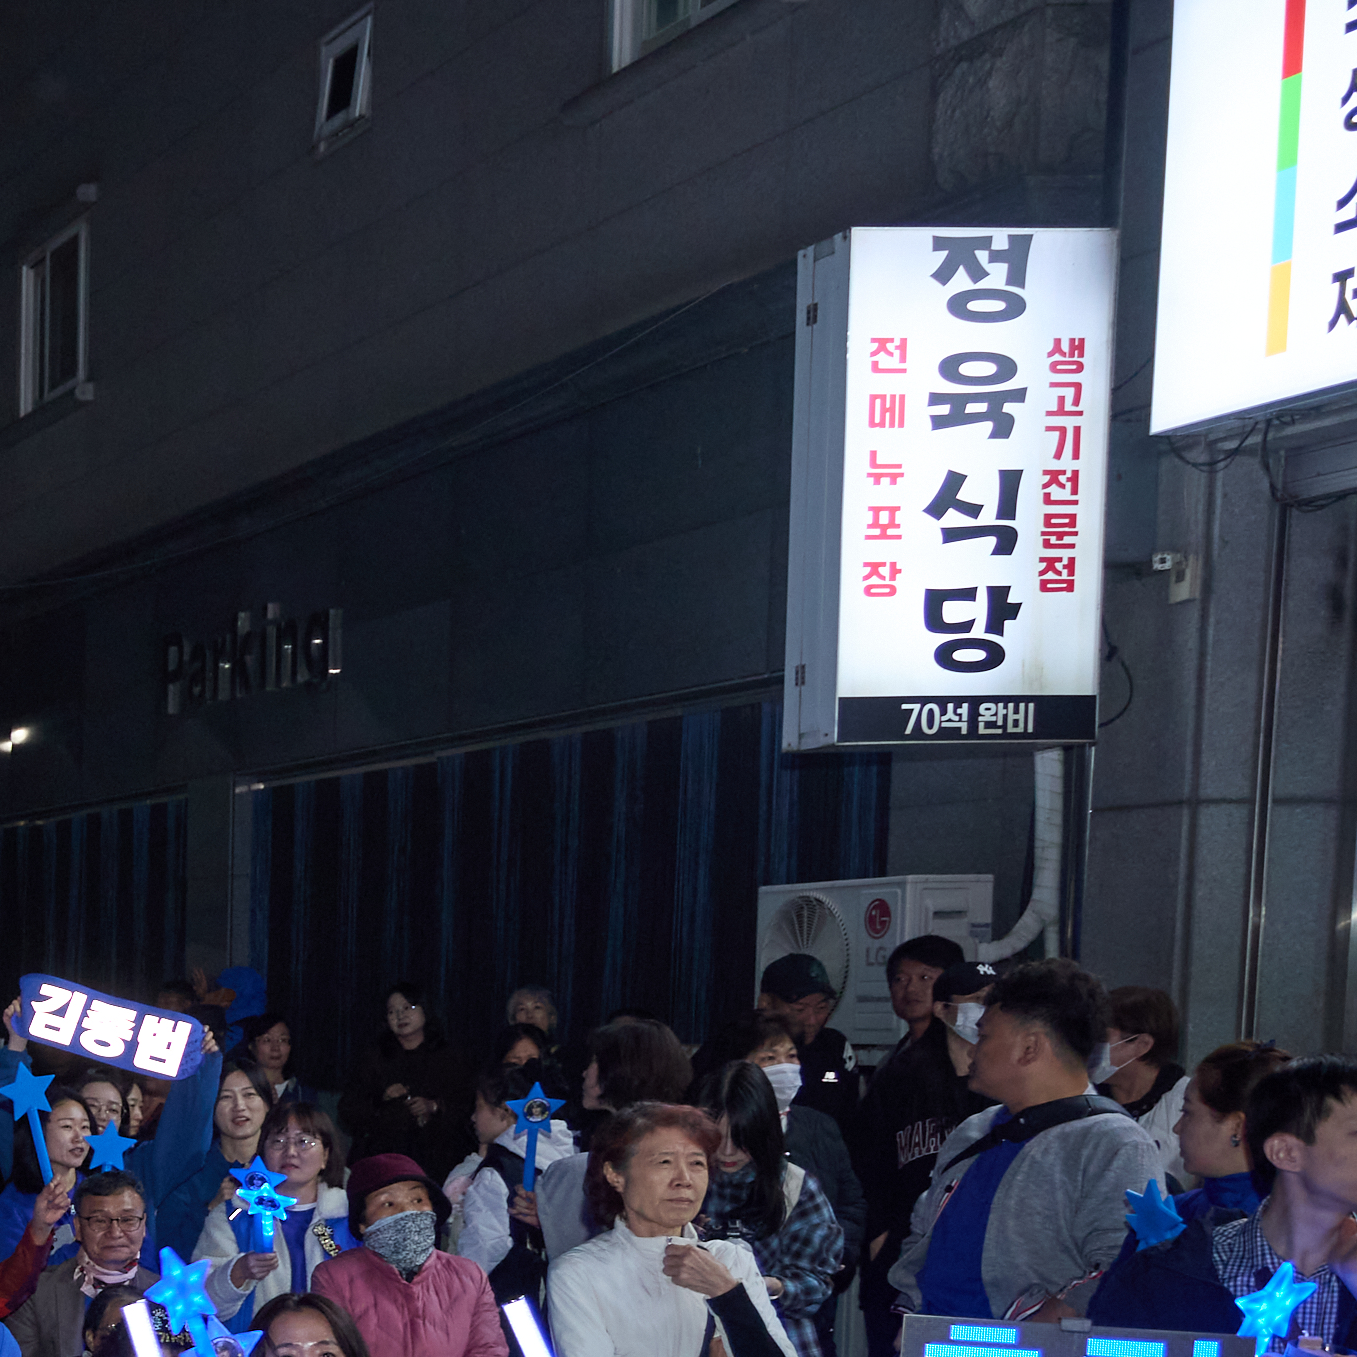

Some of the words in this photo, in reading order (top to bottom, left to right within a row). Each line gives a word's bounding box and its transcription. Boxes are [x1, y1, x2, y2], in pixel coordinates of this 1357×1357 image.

[862, 337, 909, 598] 전메뉴포장
[923, 234, 1034, 674] 정육식당
[1038, 337, 1086, 594] 생고기전문점
[162, 602, 343, 716] Parking
[901, 702, 968, 735] 70석
[977, 702, 1034, 735] 완비
[866, 946, 888, 967] LG
